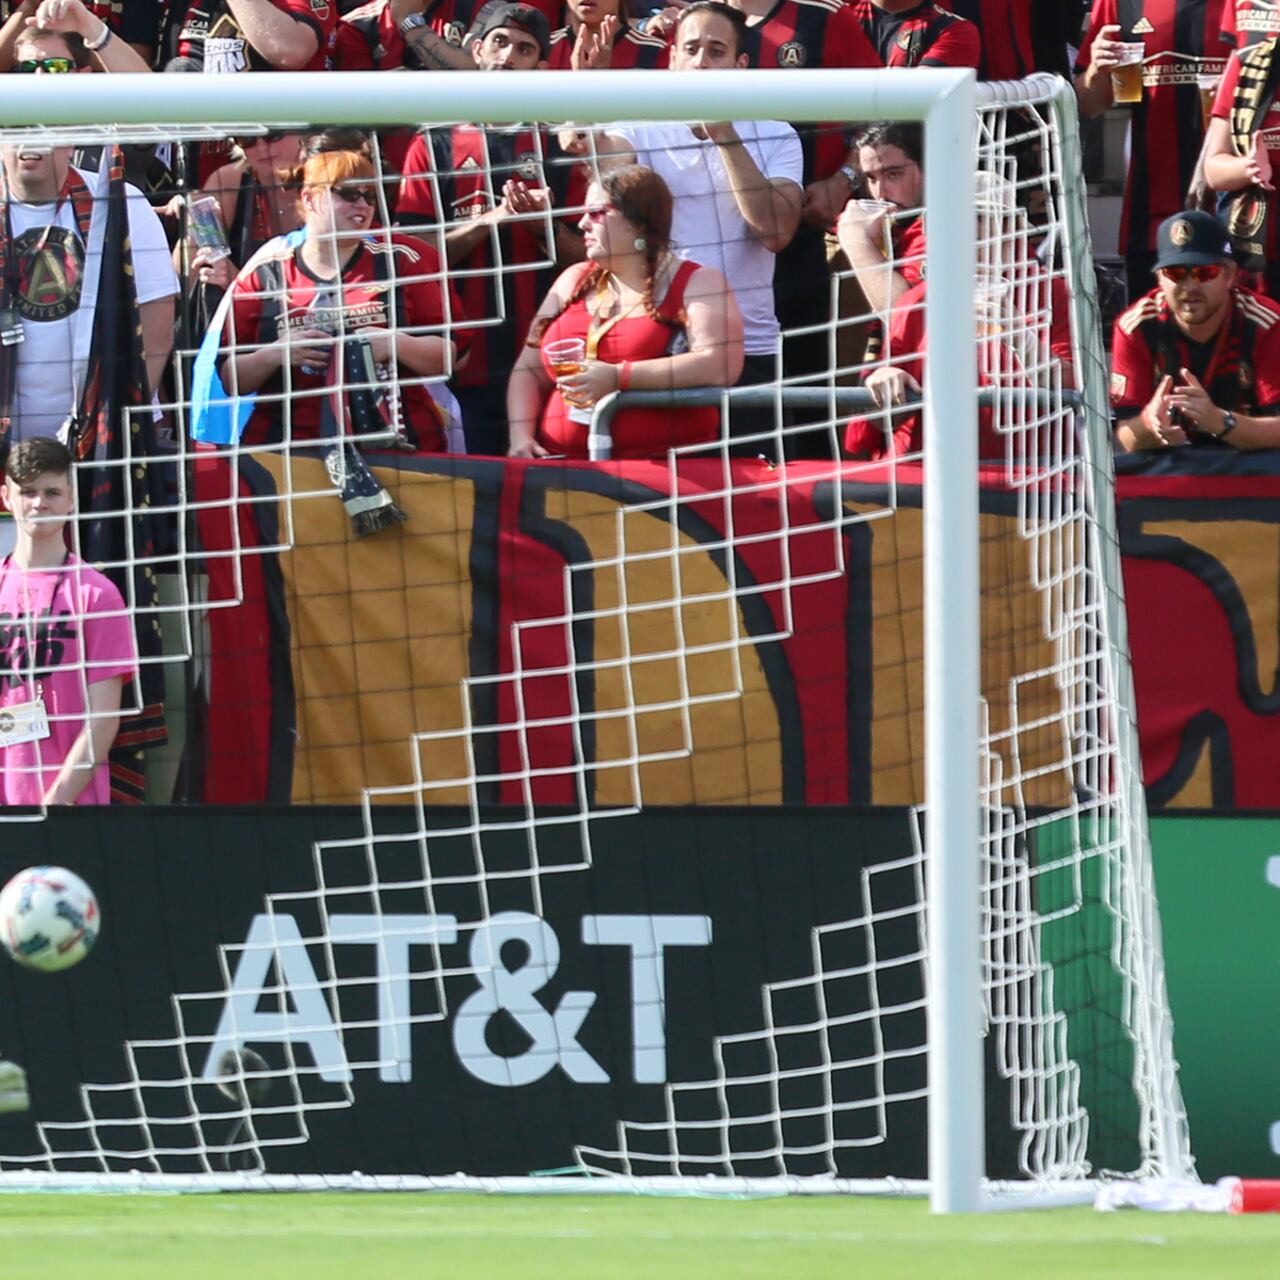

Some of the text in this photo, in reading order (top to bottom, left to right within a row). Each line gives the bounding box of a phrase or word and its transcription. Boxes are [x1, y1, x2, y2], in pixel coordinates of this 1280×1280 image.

[206, 42, 243, 53] INUS
[1143, 63, 1228, 75] AMERICAN FAMI
[343, 304, 384, 320] FAMILY
[203, 909, 714, 1087] AT&T
